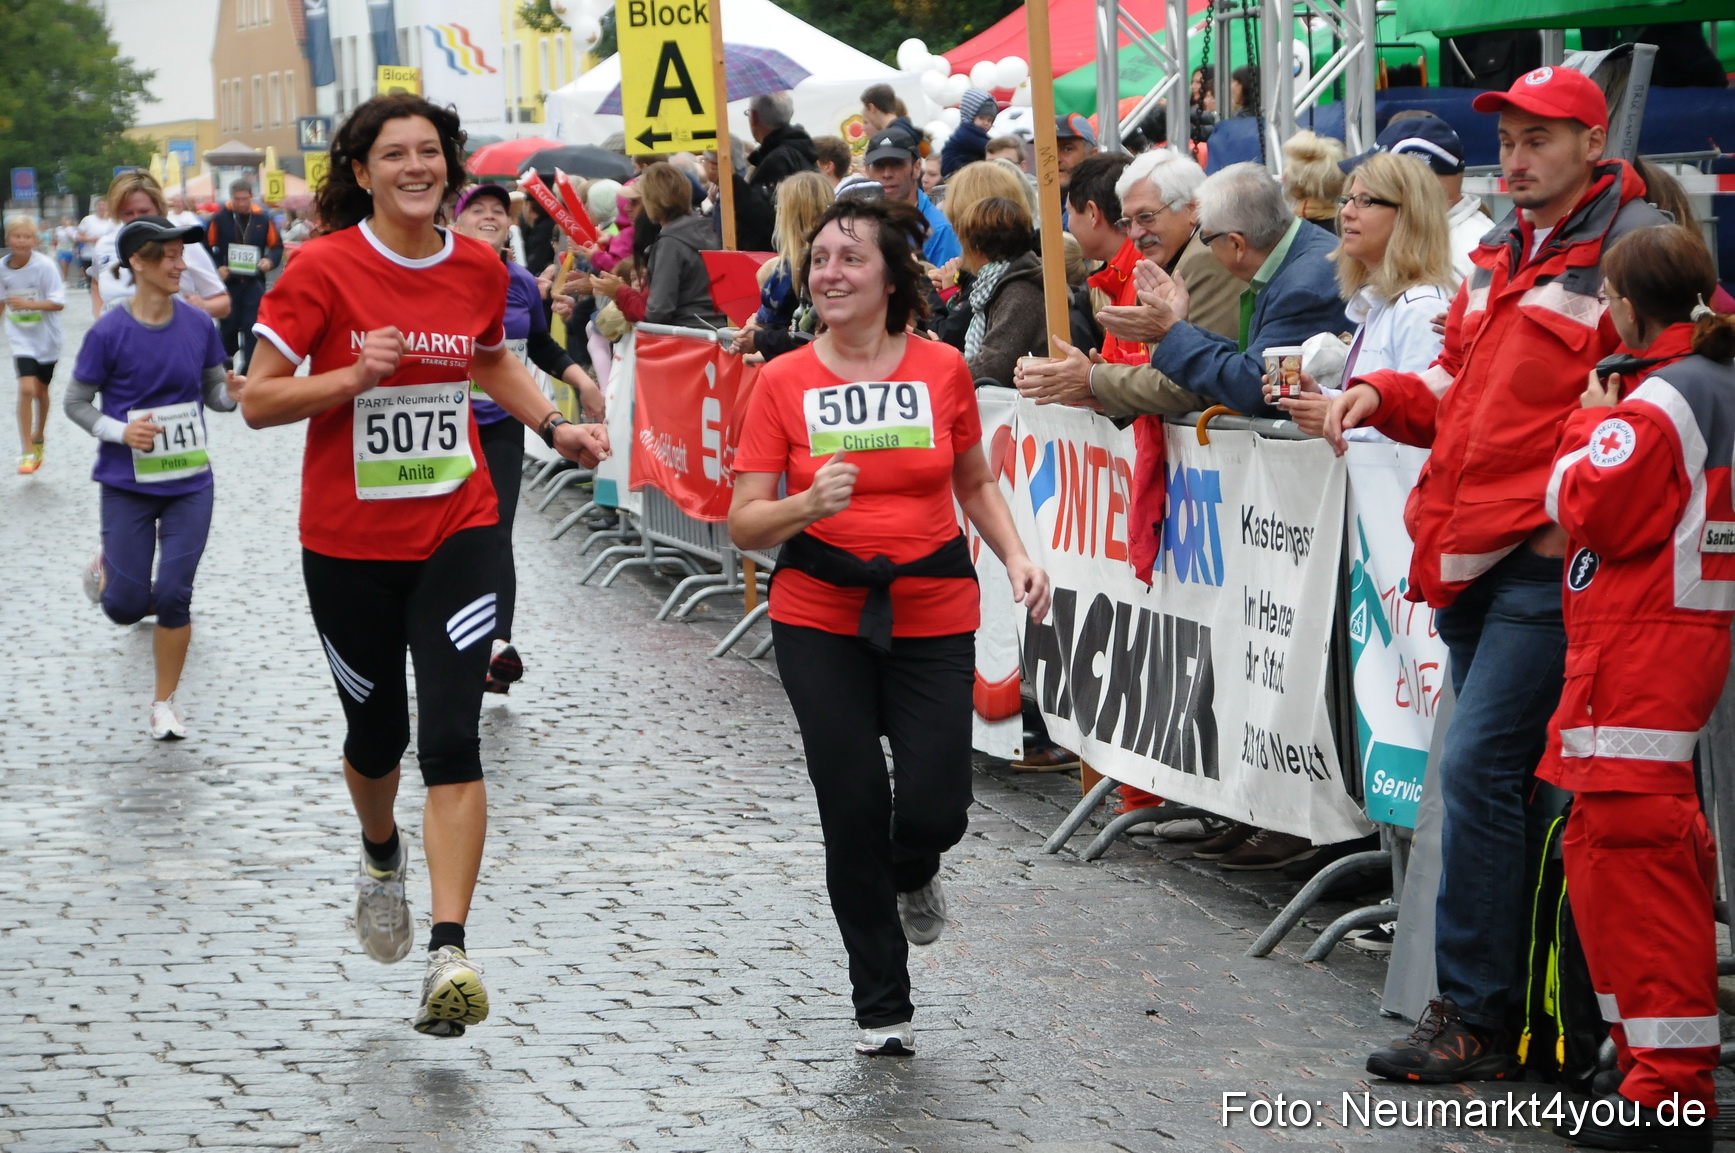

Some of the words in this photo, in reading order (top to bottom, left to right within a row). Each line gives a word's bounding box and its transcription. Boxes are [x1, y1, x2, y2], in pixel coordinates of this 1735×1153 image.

[629, 0, 709, 27] Block
[382, 69, 416, 82] Block
[645, 40, 705, 118] A
[530, 184, 558, 211] Audi
[555, 209, 580, 235] BKK
[230, 250, 254, 263] 5132
[350, 330, 471, 356] NMARKT
[421, 357, 448, 367] STARKE
[357, 396, 395, 409] PARTL
[396, 393, 450, 406] Neumarkt
[819, 383, 919, 426] 5079
[142, 421, 197, 454] 141
[366, 410, 458, 455] 5075
[843, 433, 900, 451] Christa
[1597, 422, 1633, 445] DEUTSCHES
[160, 457, 187, 470] Petra
[1601, 449, 1628, 464] KREUZ
[398, 464, 435, 482] Anita
[1052, 437, 1225, 588] INTERPORT
